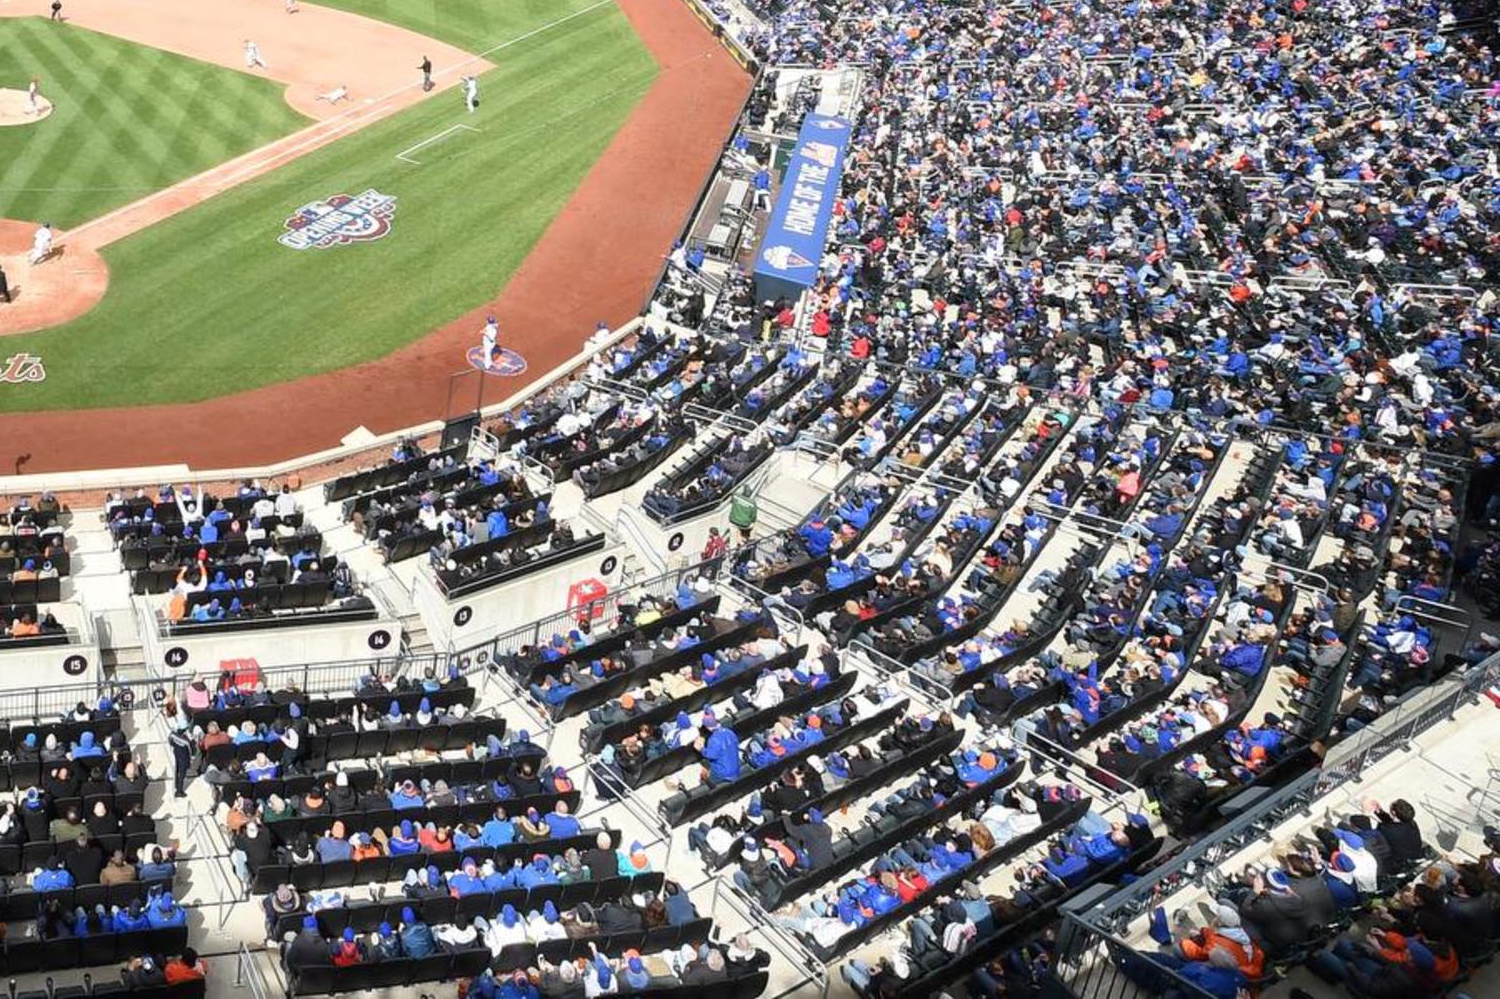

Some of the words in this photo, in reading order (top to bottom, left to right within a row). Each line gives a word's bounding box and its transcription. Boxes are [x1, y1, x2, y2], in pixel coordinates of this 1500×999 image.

[798, 164, 830, 185] THE
[793, 185, 823, 201] OF
[782, 198, 821, 236] HOME
[70, 660, 81, 670] 15
[171, 652, 182, 662] 14
